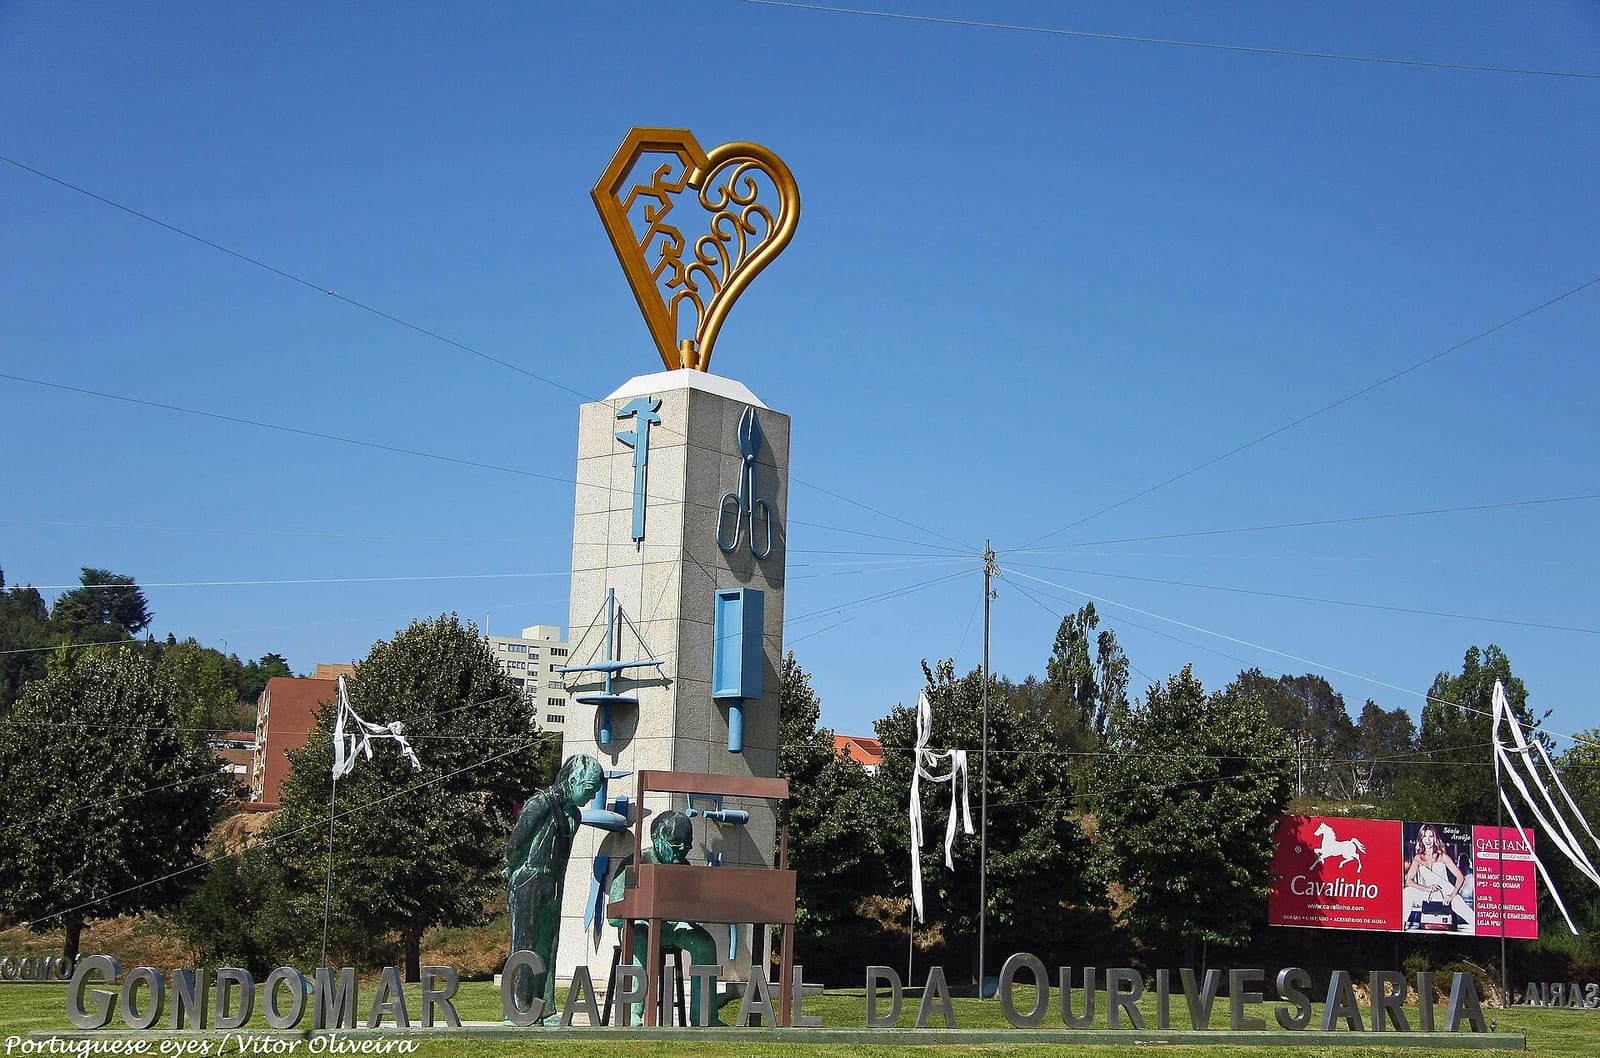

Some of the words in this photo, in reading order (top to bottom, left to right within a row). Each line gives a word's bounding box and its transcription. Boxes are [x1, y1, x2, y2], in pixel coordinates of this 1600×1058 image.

[1290, 875, 1379, 899] Cavalinho
[66, 954, 463, 1029] GONDOMAR
[502, 950, 823, 1028] CAPITAL
[866, 965, 958, 1029] DA
[1000, 951, 1488, 1033] OURIVESARIA
